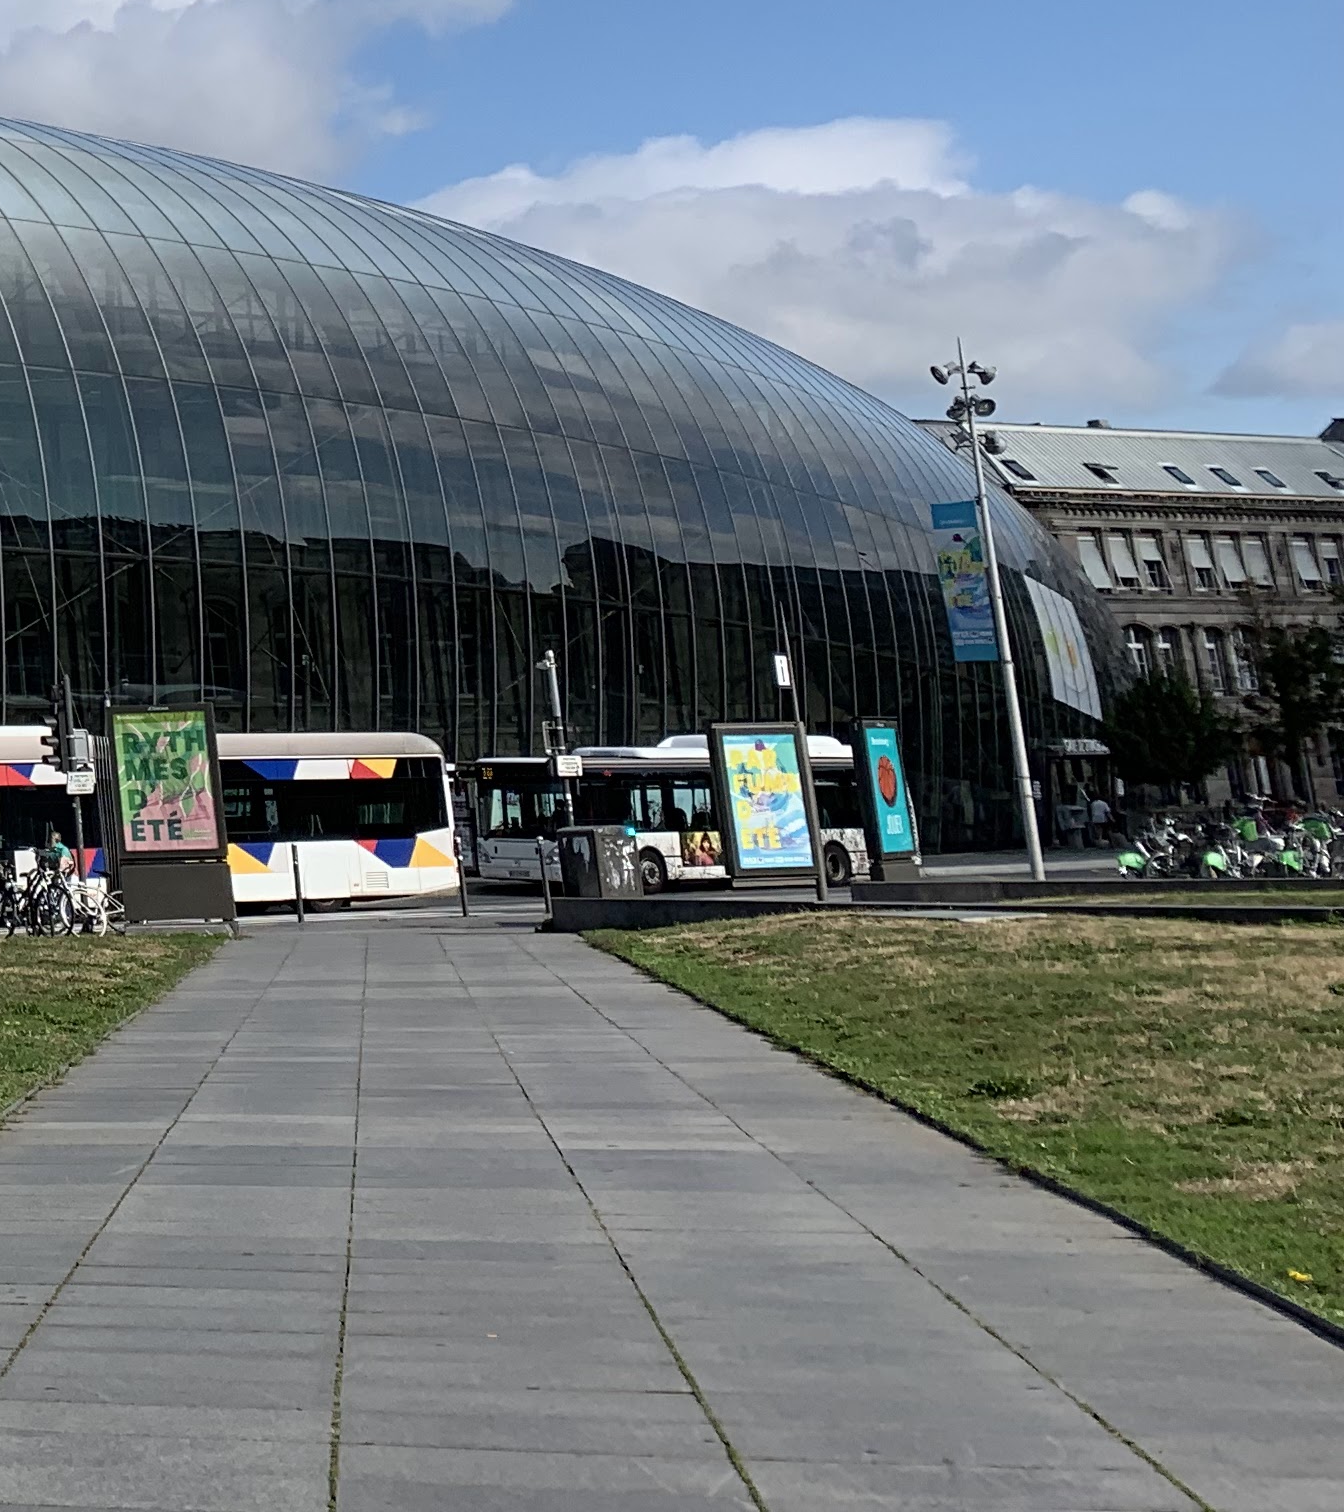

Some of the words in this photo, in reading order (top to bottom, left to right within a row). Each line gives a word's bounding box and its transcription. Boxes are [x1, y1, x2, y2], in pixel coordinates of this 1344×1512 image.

[121, 729, 205, 755] RYTH
[123, 757, 189, 782] MES
[730, 749, 777, 770] PAR
[130, 810, 184, 842] ÉTÉ
